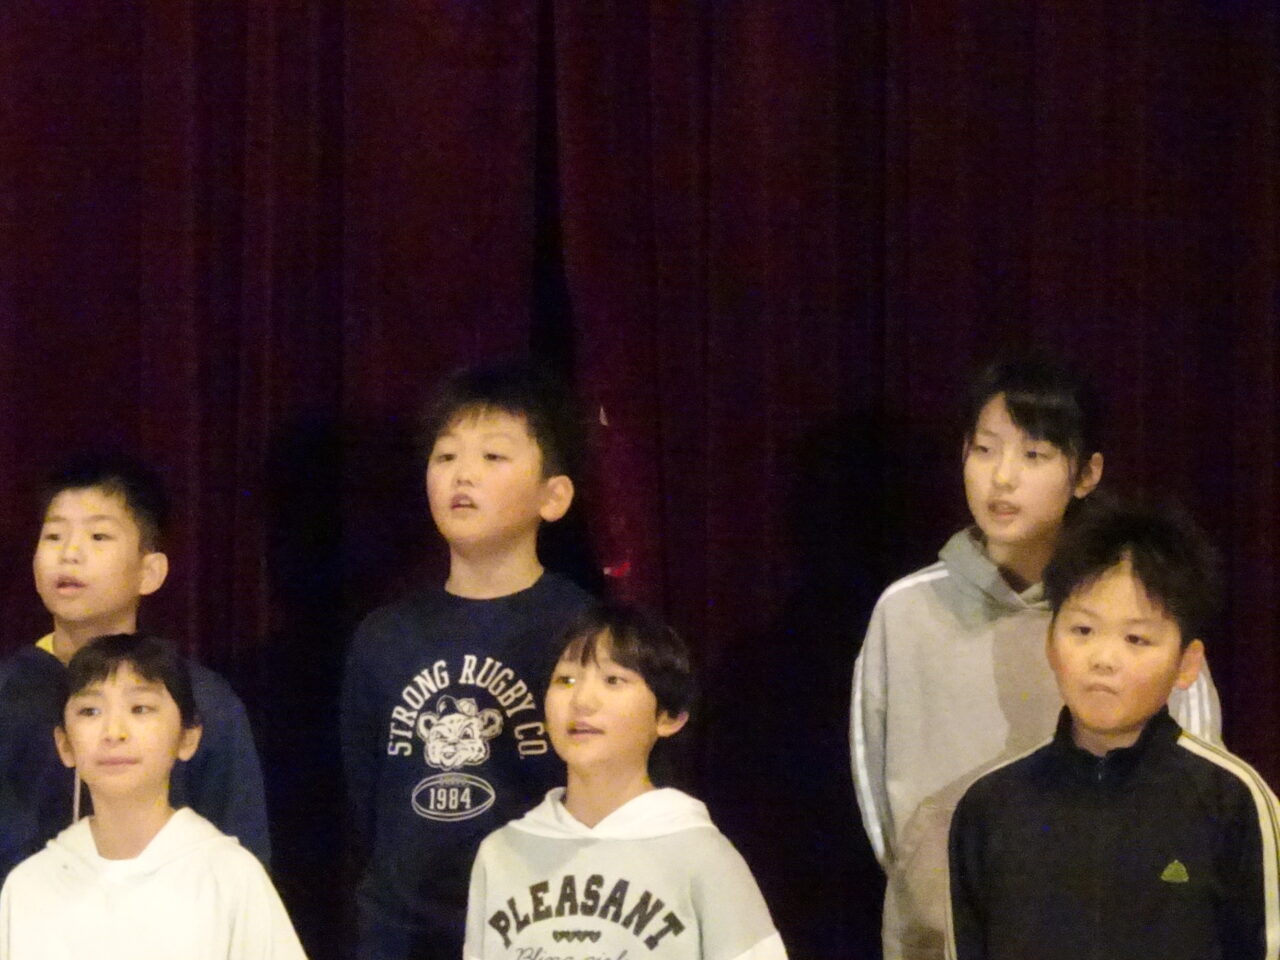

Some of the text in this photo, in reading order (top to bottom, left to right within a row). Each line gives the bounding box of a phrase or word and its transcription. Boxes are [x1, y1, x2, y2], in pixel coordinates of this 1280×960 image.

[387, 660, 450, 756] STRONG
[459, 654, 536, 718] RUGBY
[429, 787, 470, 810] 1984
[488, 874, 686, 950] PLEASANT
